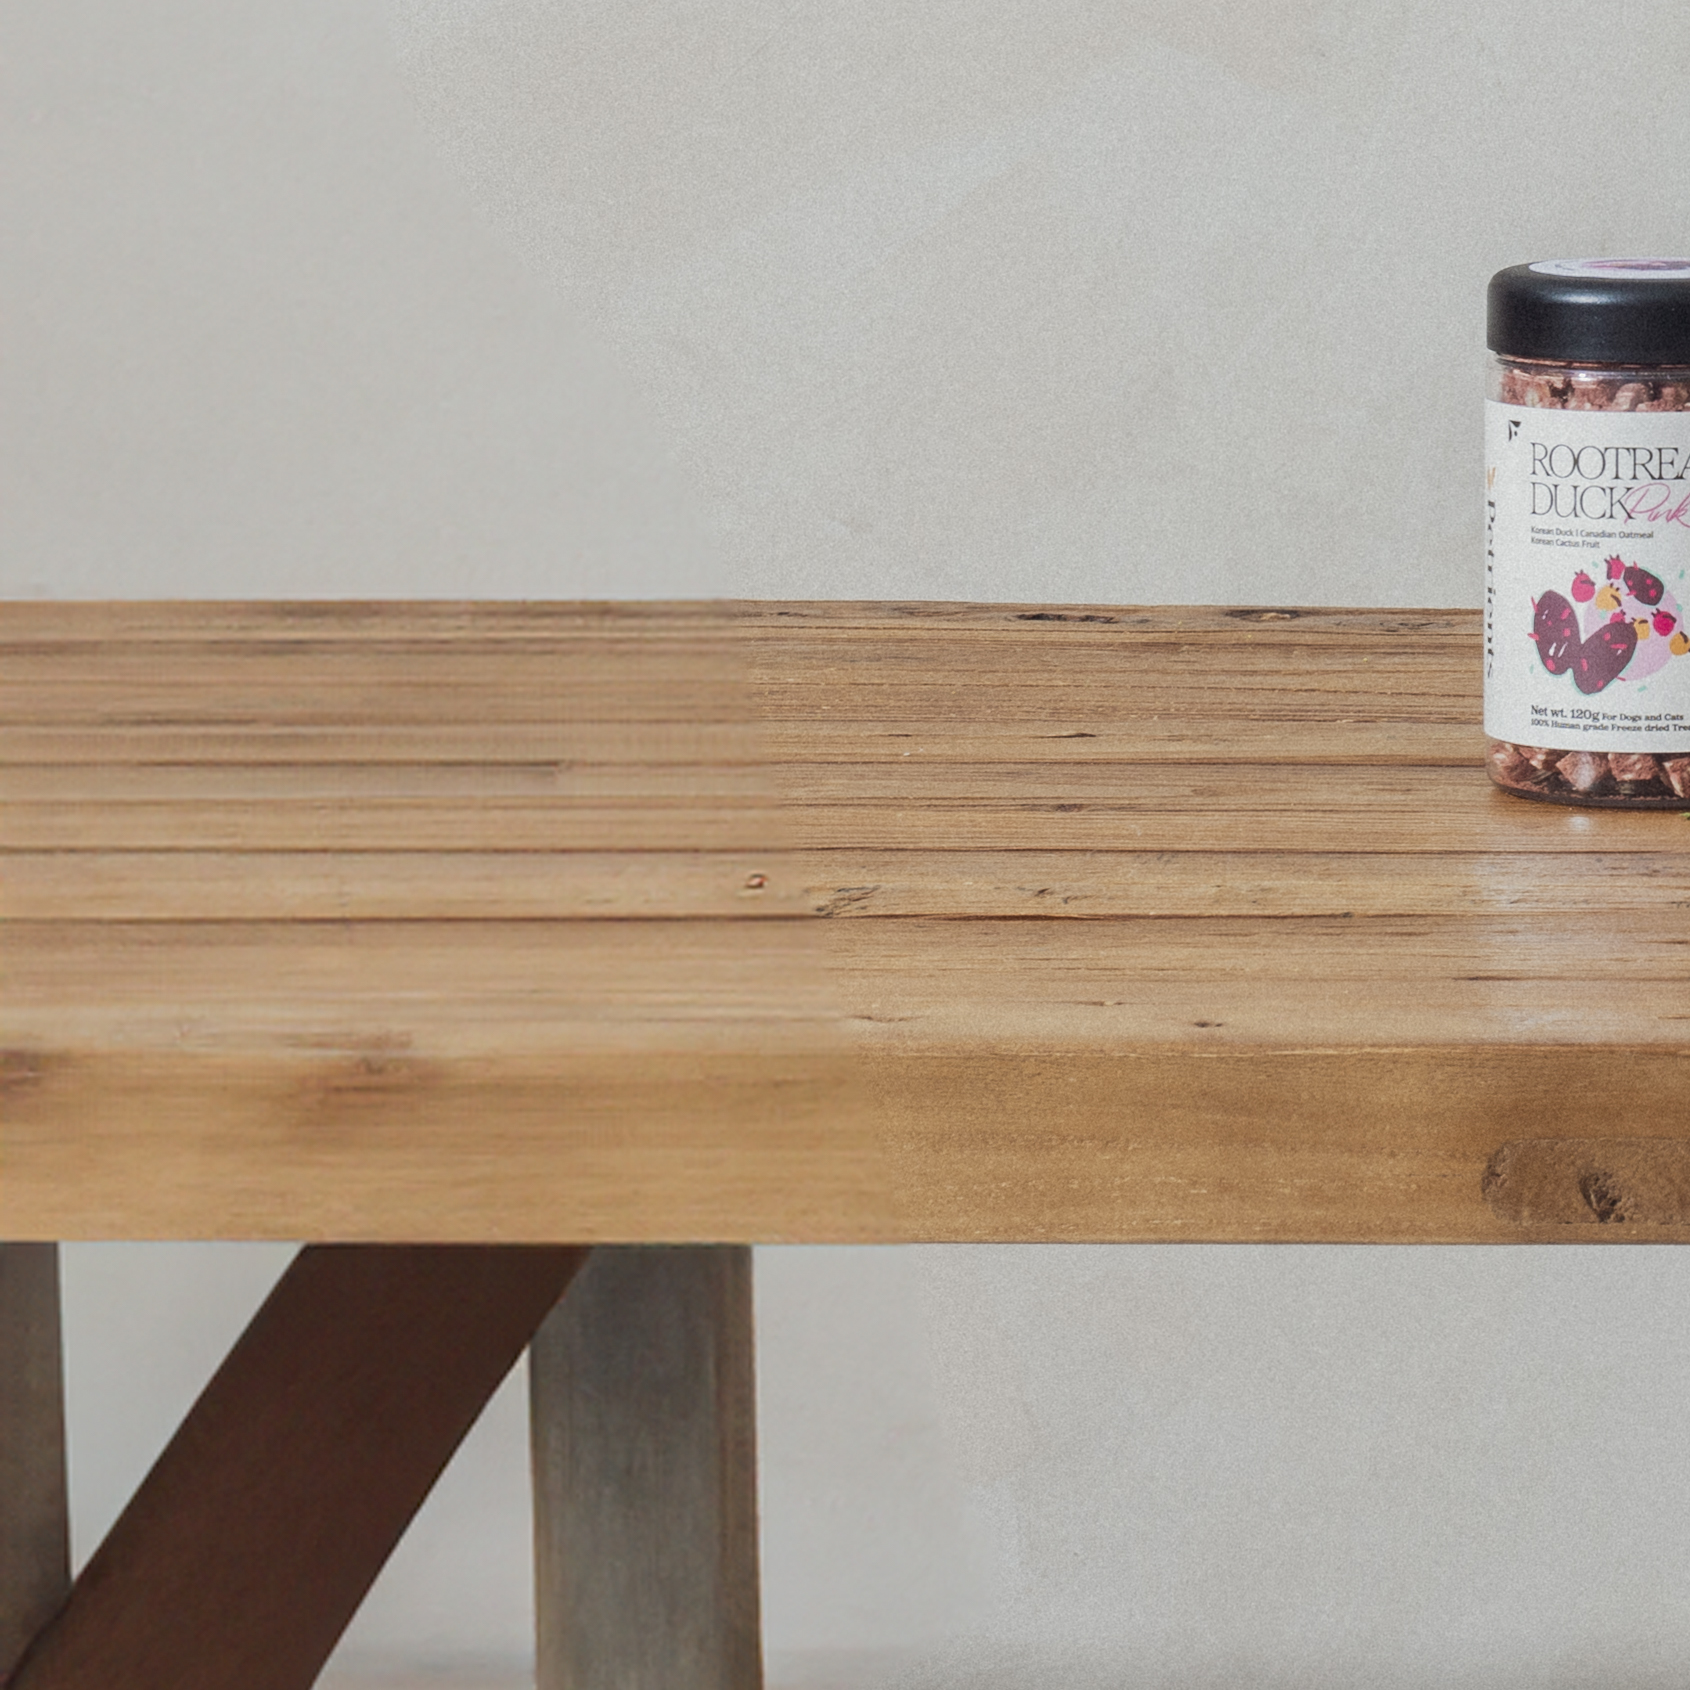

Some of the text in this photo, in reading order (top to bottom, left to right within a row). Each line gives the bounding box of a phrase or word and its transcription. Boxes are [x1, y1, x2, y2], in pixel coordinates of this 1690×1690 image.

[1530, 482, 1635, 519] DUCK
[1531, 526, 1554, 535] Korean
[1556, 528, 1574, 536] Duck
[1580, 530, 1616, 538] Canadian
[1531, 536, 1600, 548] Korean Cactus Fruit
[1531, 705, 1548, 716] Net
[1550, 709, 1567, 718] wt.
[1571, 709, 1600, 722] 120g
[1620, 714, 1642, 722] Dogs
[1531, 719, 1549, 727] 100%
[1551, 720, 1580, 729] Human
[1583, 723, 1609, 731] grade
